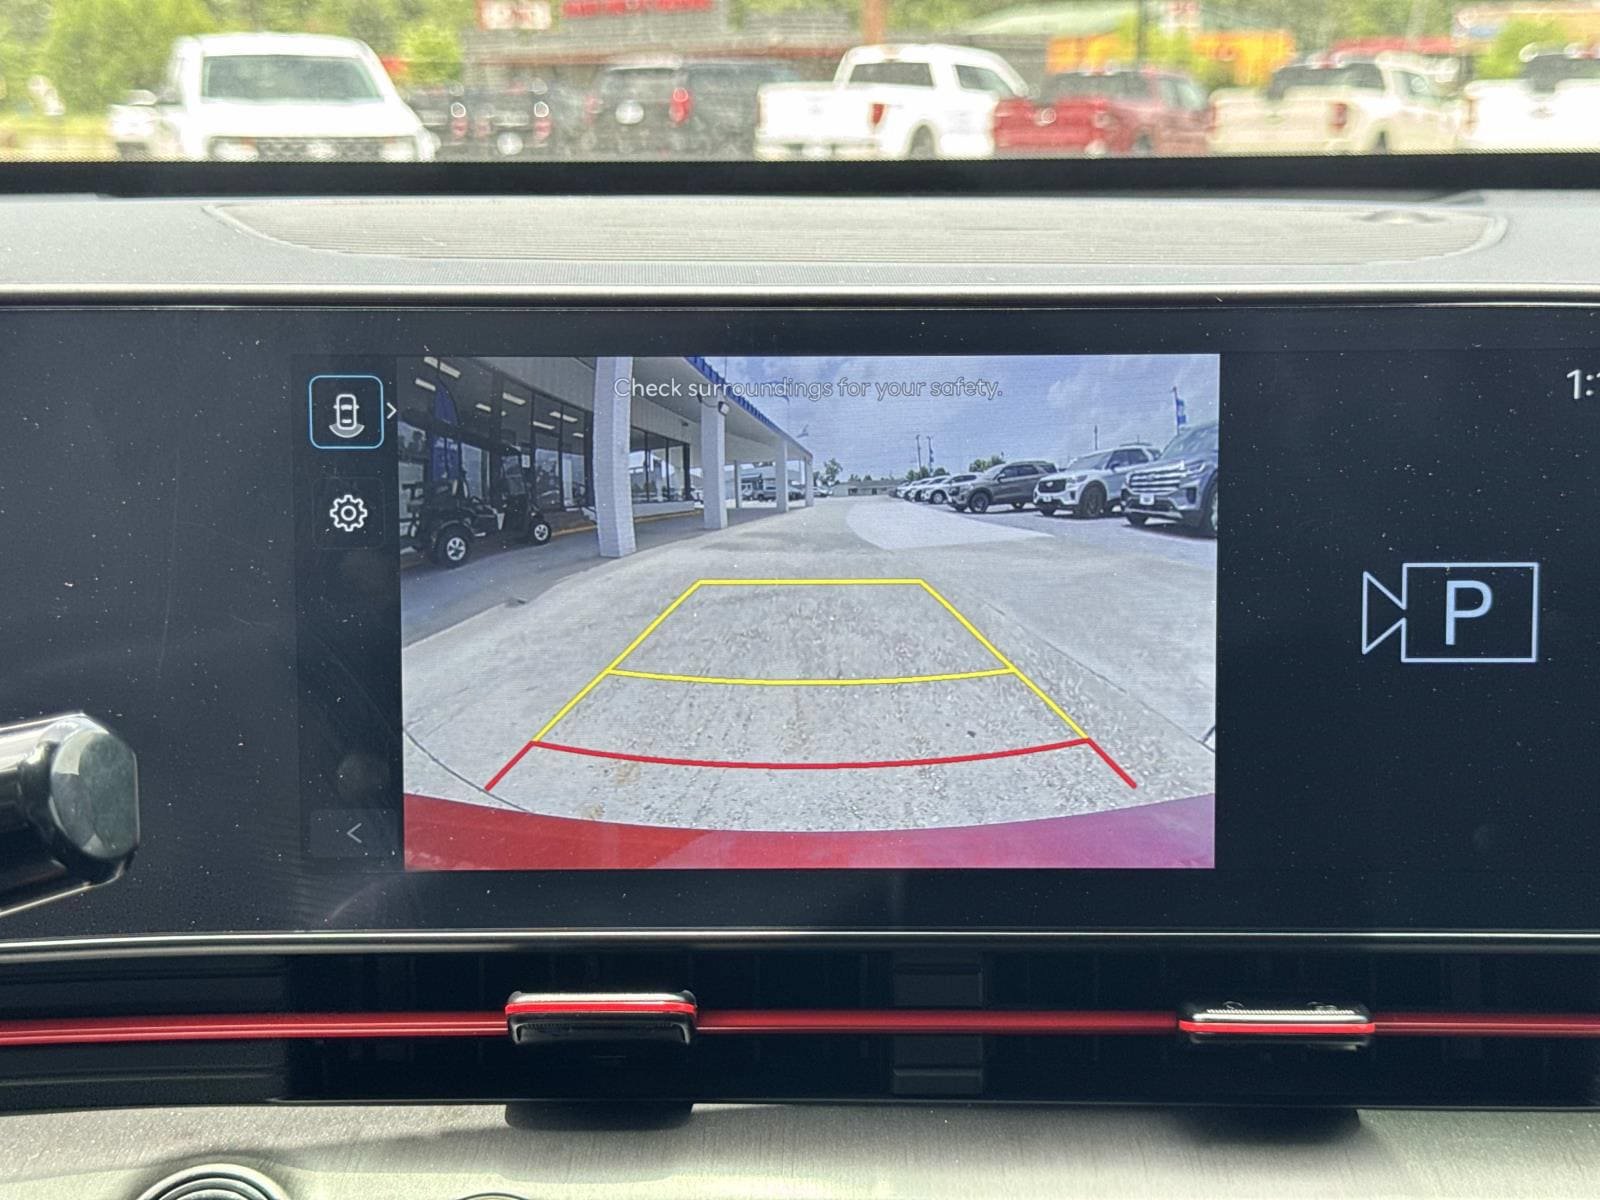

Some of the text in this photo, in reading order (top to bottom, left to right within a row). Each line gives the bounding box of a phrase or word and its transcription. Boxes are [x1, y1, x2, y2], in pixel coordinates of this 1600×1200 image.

[614, 376, 1003, 401] Check surroundings for your safety.
[1566, 369, 1600, 400] 1:
[1445, 579, 1493, 645] P
